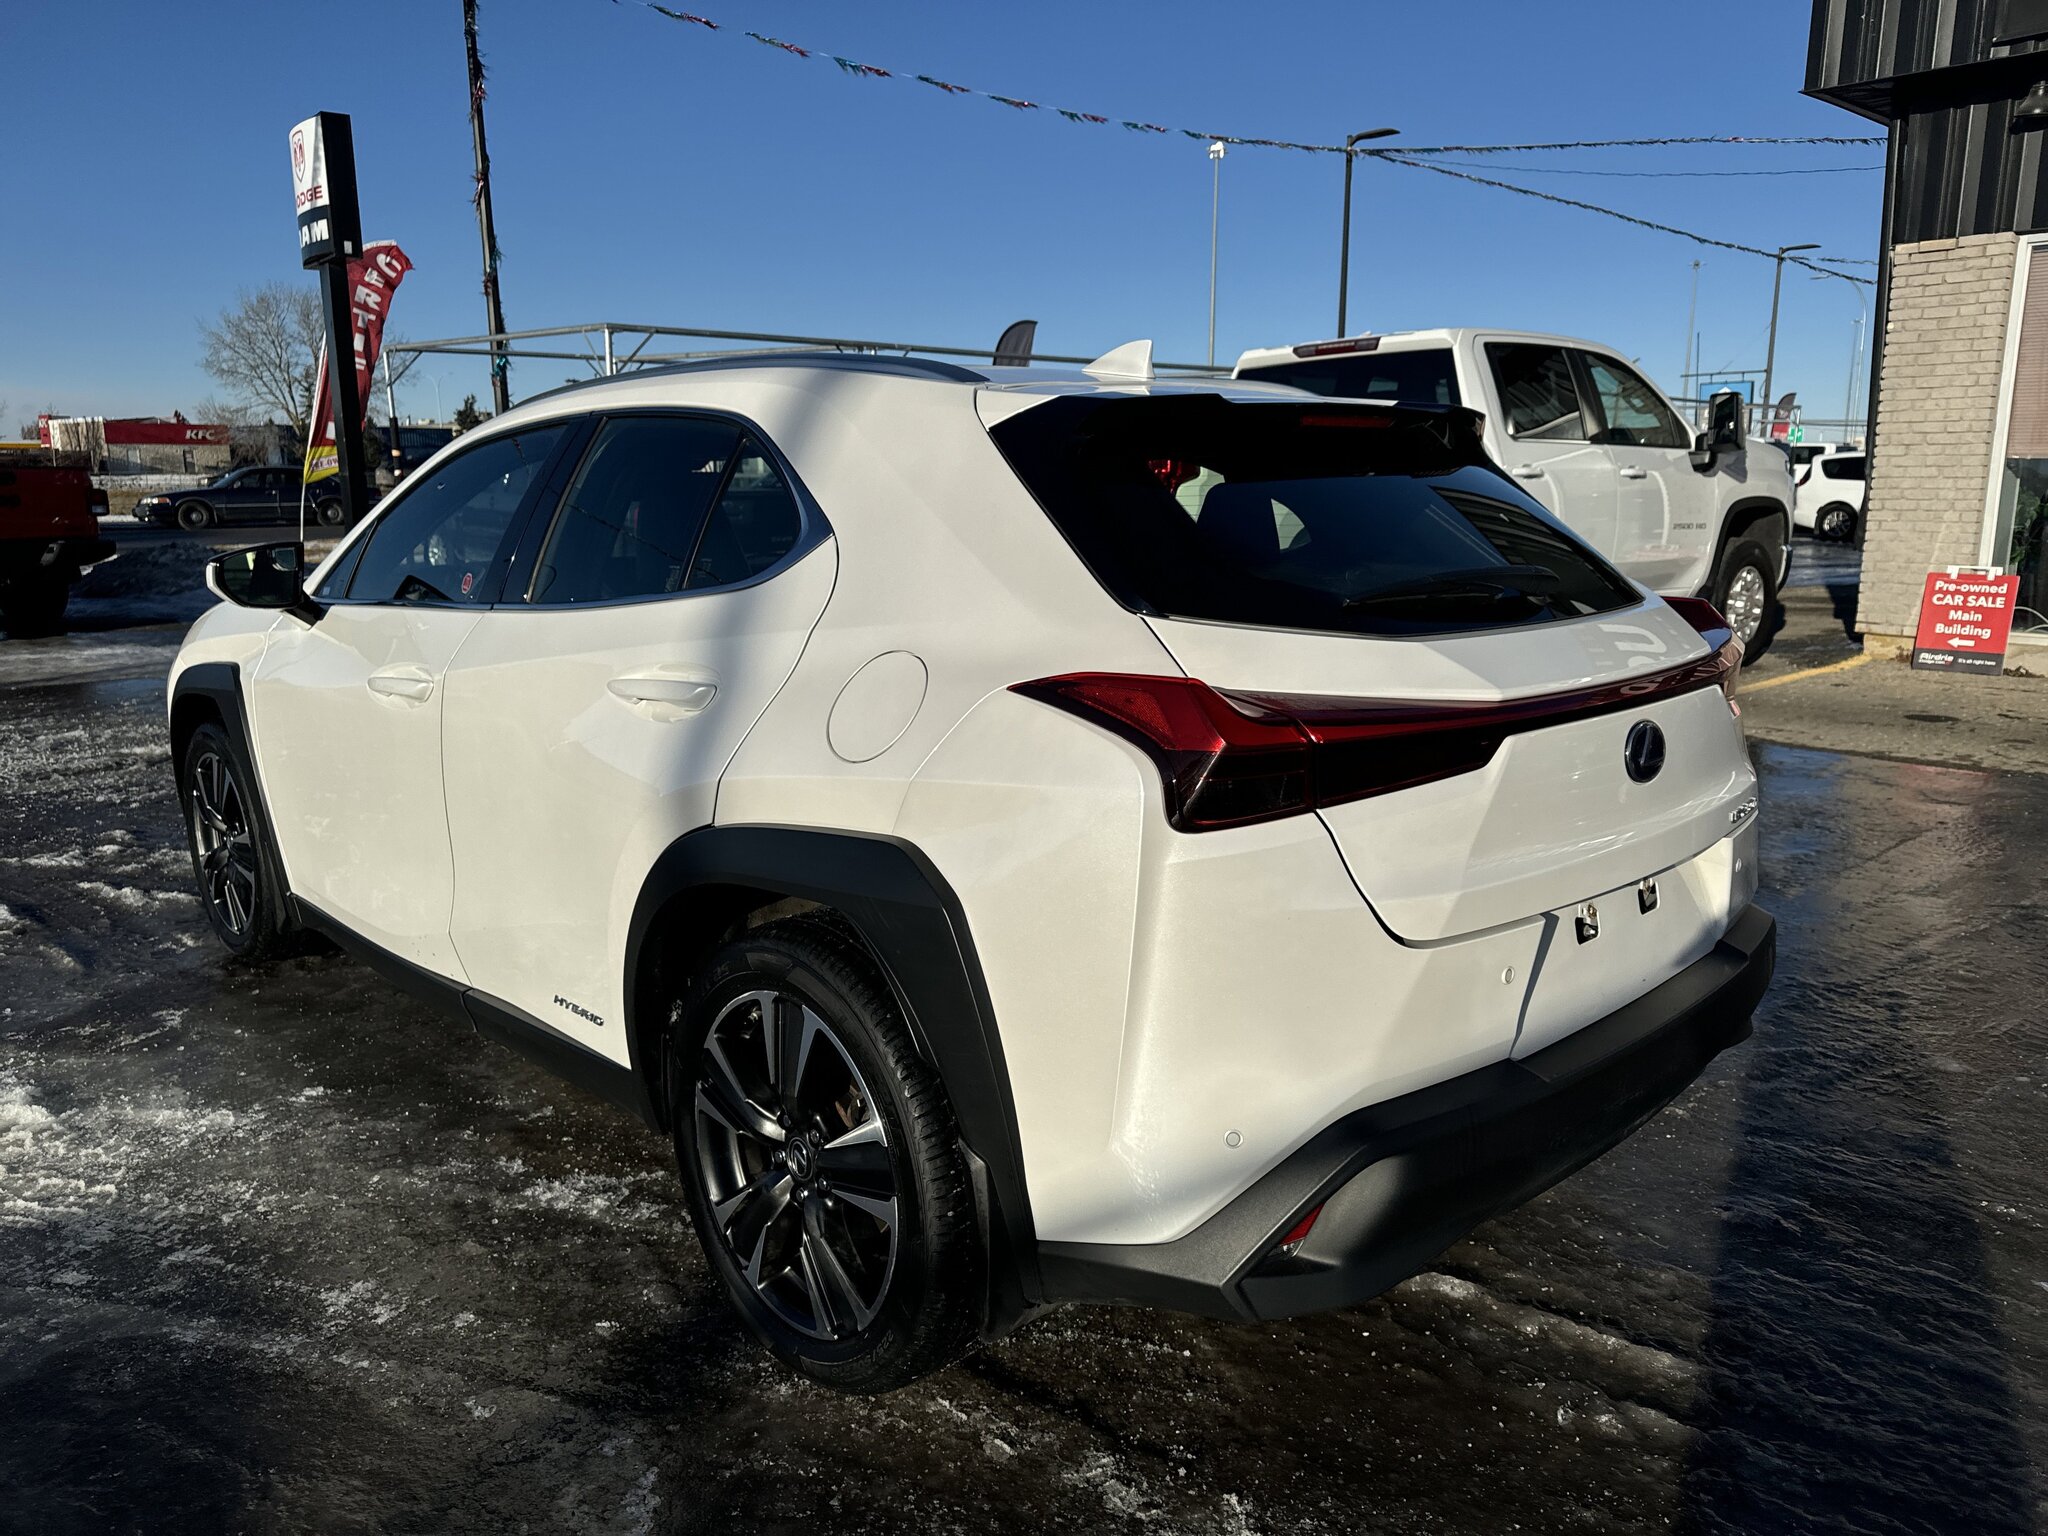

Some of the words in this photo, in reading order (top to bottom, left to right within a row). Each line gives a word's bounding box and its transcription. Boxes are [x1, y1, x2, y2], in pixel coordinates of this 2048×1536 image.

[299, 218, 329, 248] AM
[185, 429, 215, 440] KFC
[1935, 581, 2008, 594] Pre-owned
[1932, 593, 1964, 606] CAR
[1966, 595, 2006, 608] SALE
[1948, 609, 1982, 622] Main
[1935, 623, 1991, 639] Building
[554, 994, 604, 1026] HYBRID
